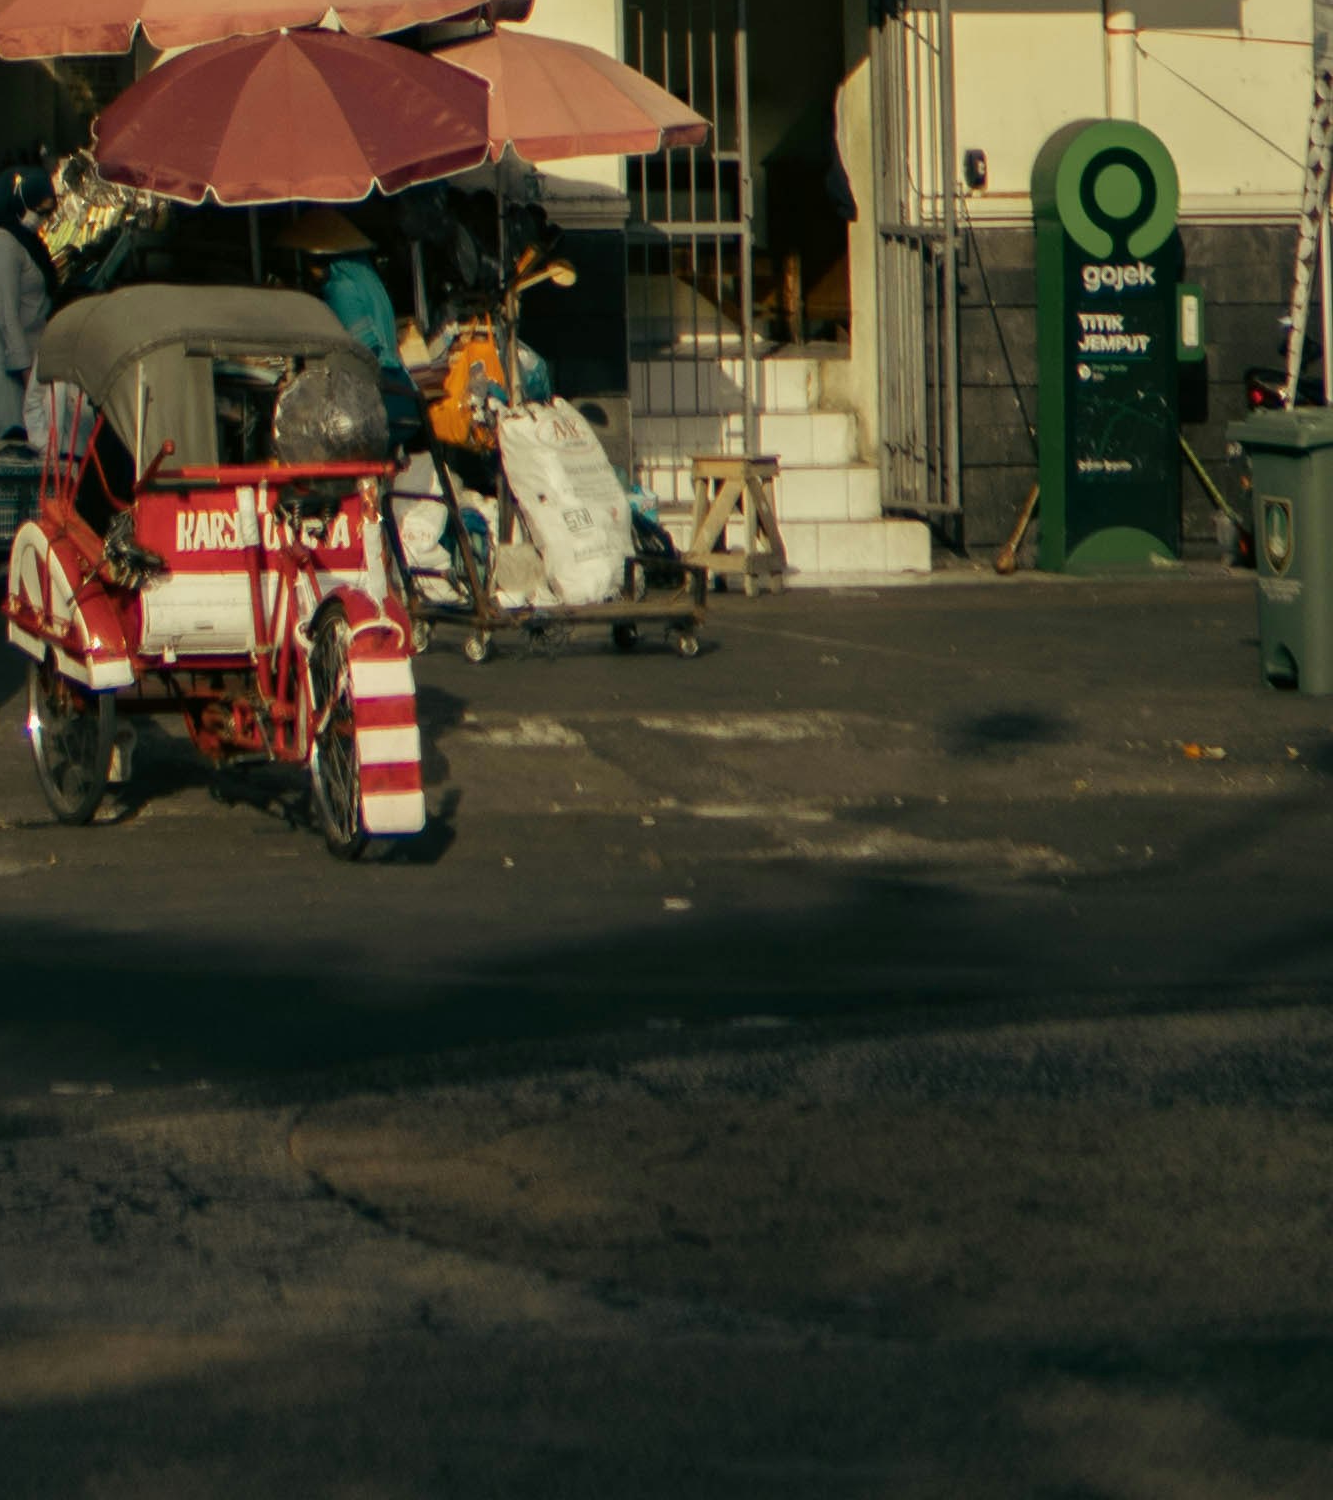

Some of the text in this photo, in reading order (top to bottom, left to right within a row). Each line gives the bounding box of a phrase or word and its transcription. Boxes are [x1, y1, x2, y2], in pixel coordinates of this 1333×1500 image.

[1082, 260, 1157, 293] gojek
[1077, 312, 1125, 332] TITIK
[1077, 333, 1152, 354] JEMPUT
[176, 510, 249, 552] KARY
